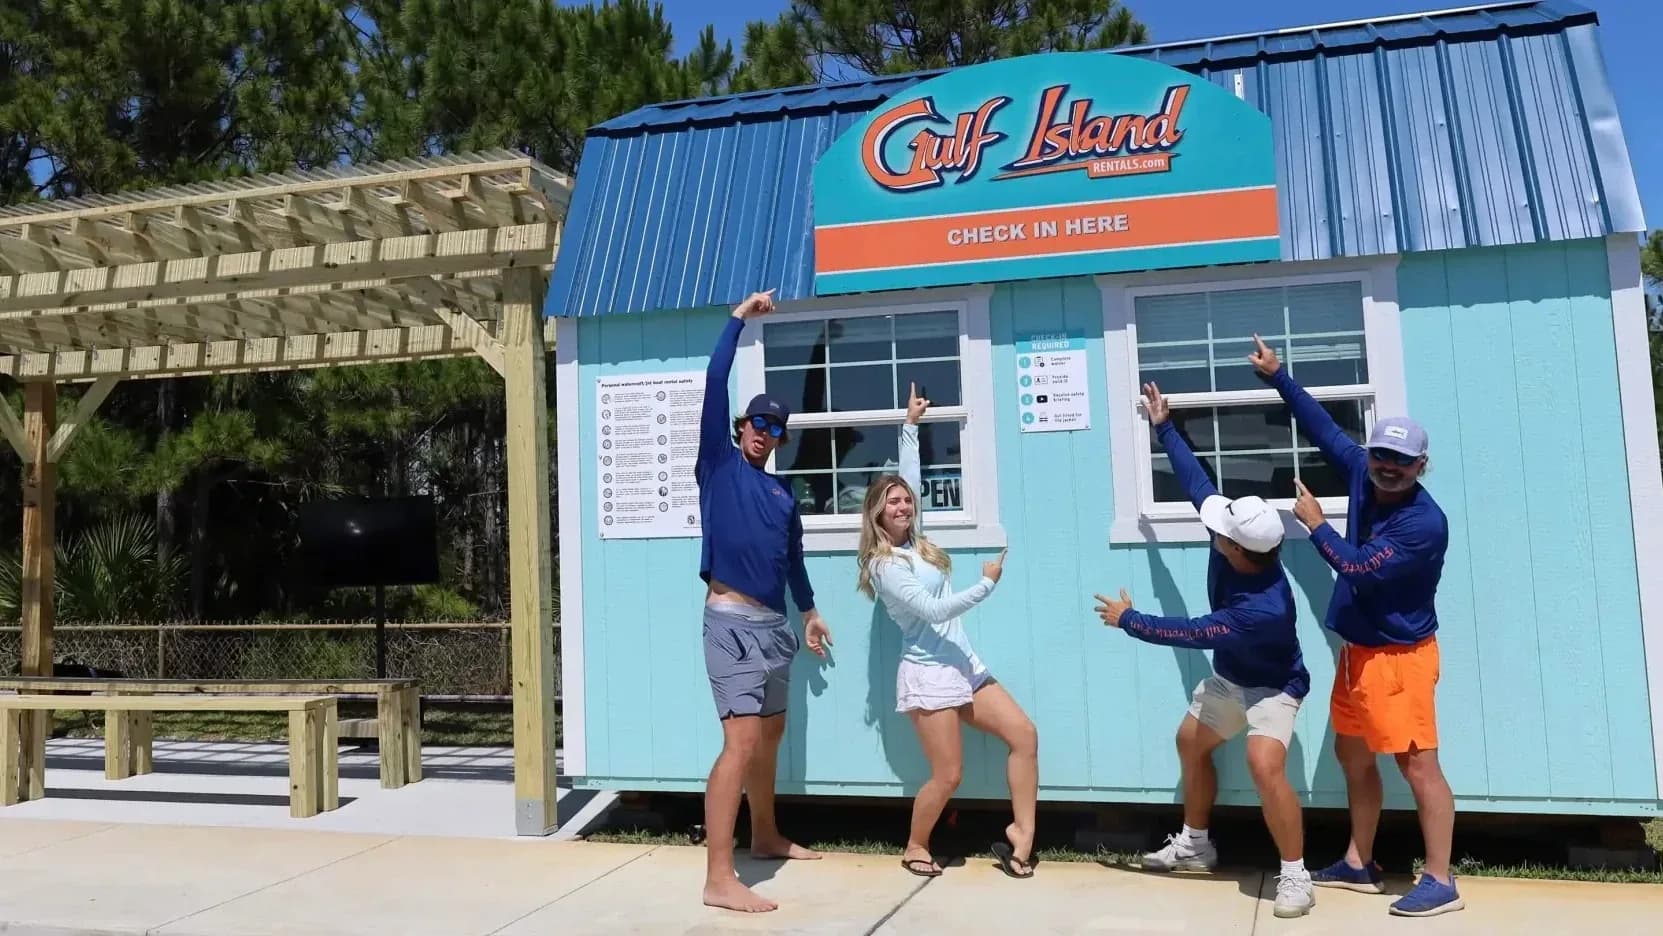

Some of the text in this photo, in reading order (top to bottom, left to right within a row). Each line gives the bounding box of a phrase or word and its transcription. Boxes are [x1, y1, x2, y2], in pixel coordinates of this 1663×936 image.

[861, 84, 1190, 193] Gulf Island
[1093, 158, 1165, 173] RENTALS.com
[947, 214, 1129, 245] CHECK IN HERE
[1031, 341, 1070, 351] REQUIRED
[920, 479, 961, 507] PEN
